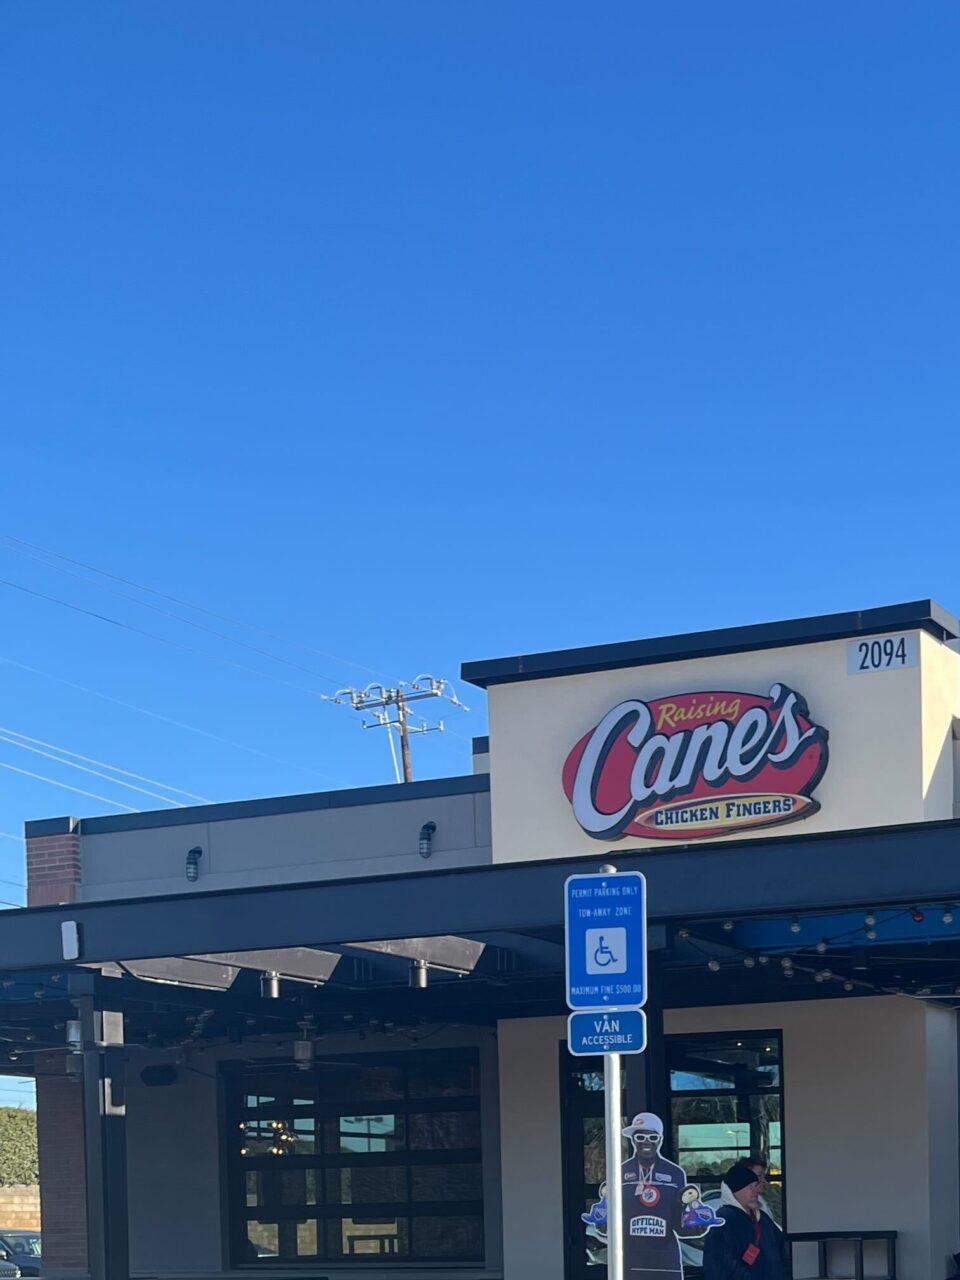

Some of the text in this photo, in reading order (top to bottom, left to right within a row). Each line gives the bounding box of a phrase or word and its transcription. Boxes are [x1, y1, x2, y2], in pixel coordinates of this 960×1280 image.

[858, 637, 907, 671] 2094
[657, 697, 741, 731] Raising
[572, 683, 814, 833] Cane's
[654, 798, 793, 826] CHICKEN FINGERS
[571, 886, 638, 898] PERMIT PARKING ONLY
[579, 906, 632, 918] TOW-AWAY ZONE
[571, 983, 642, 995] MAXIMUM FINE $500.00
[594, 1020, 620, 1033] VAN
[582, 1034, 633, 1046] ACCESSIBLE
[631, 1218, 664, 1228] OFFICIAL
[631, 1227, 664, 1236] HYPE MAN
